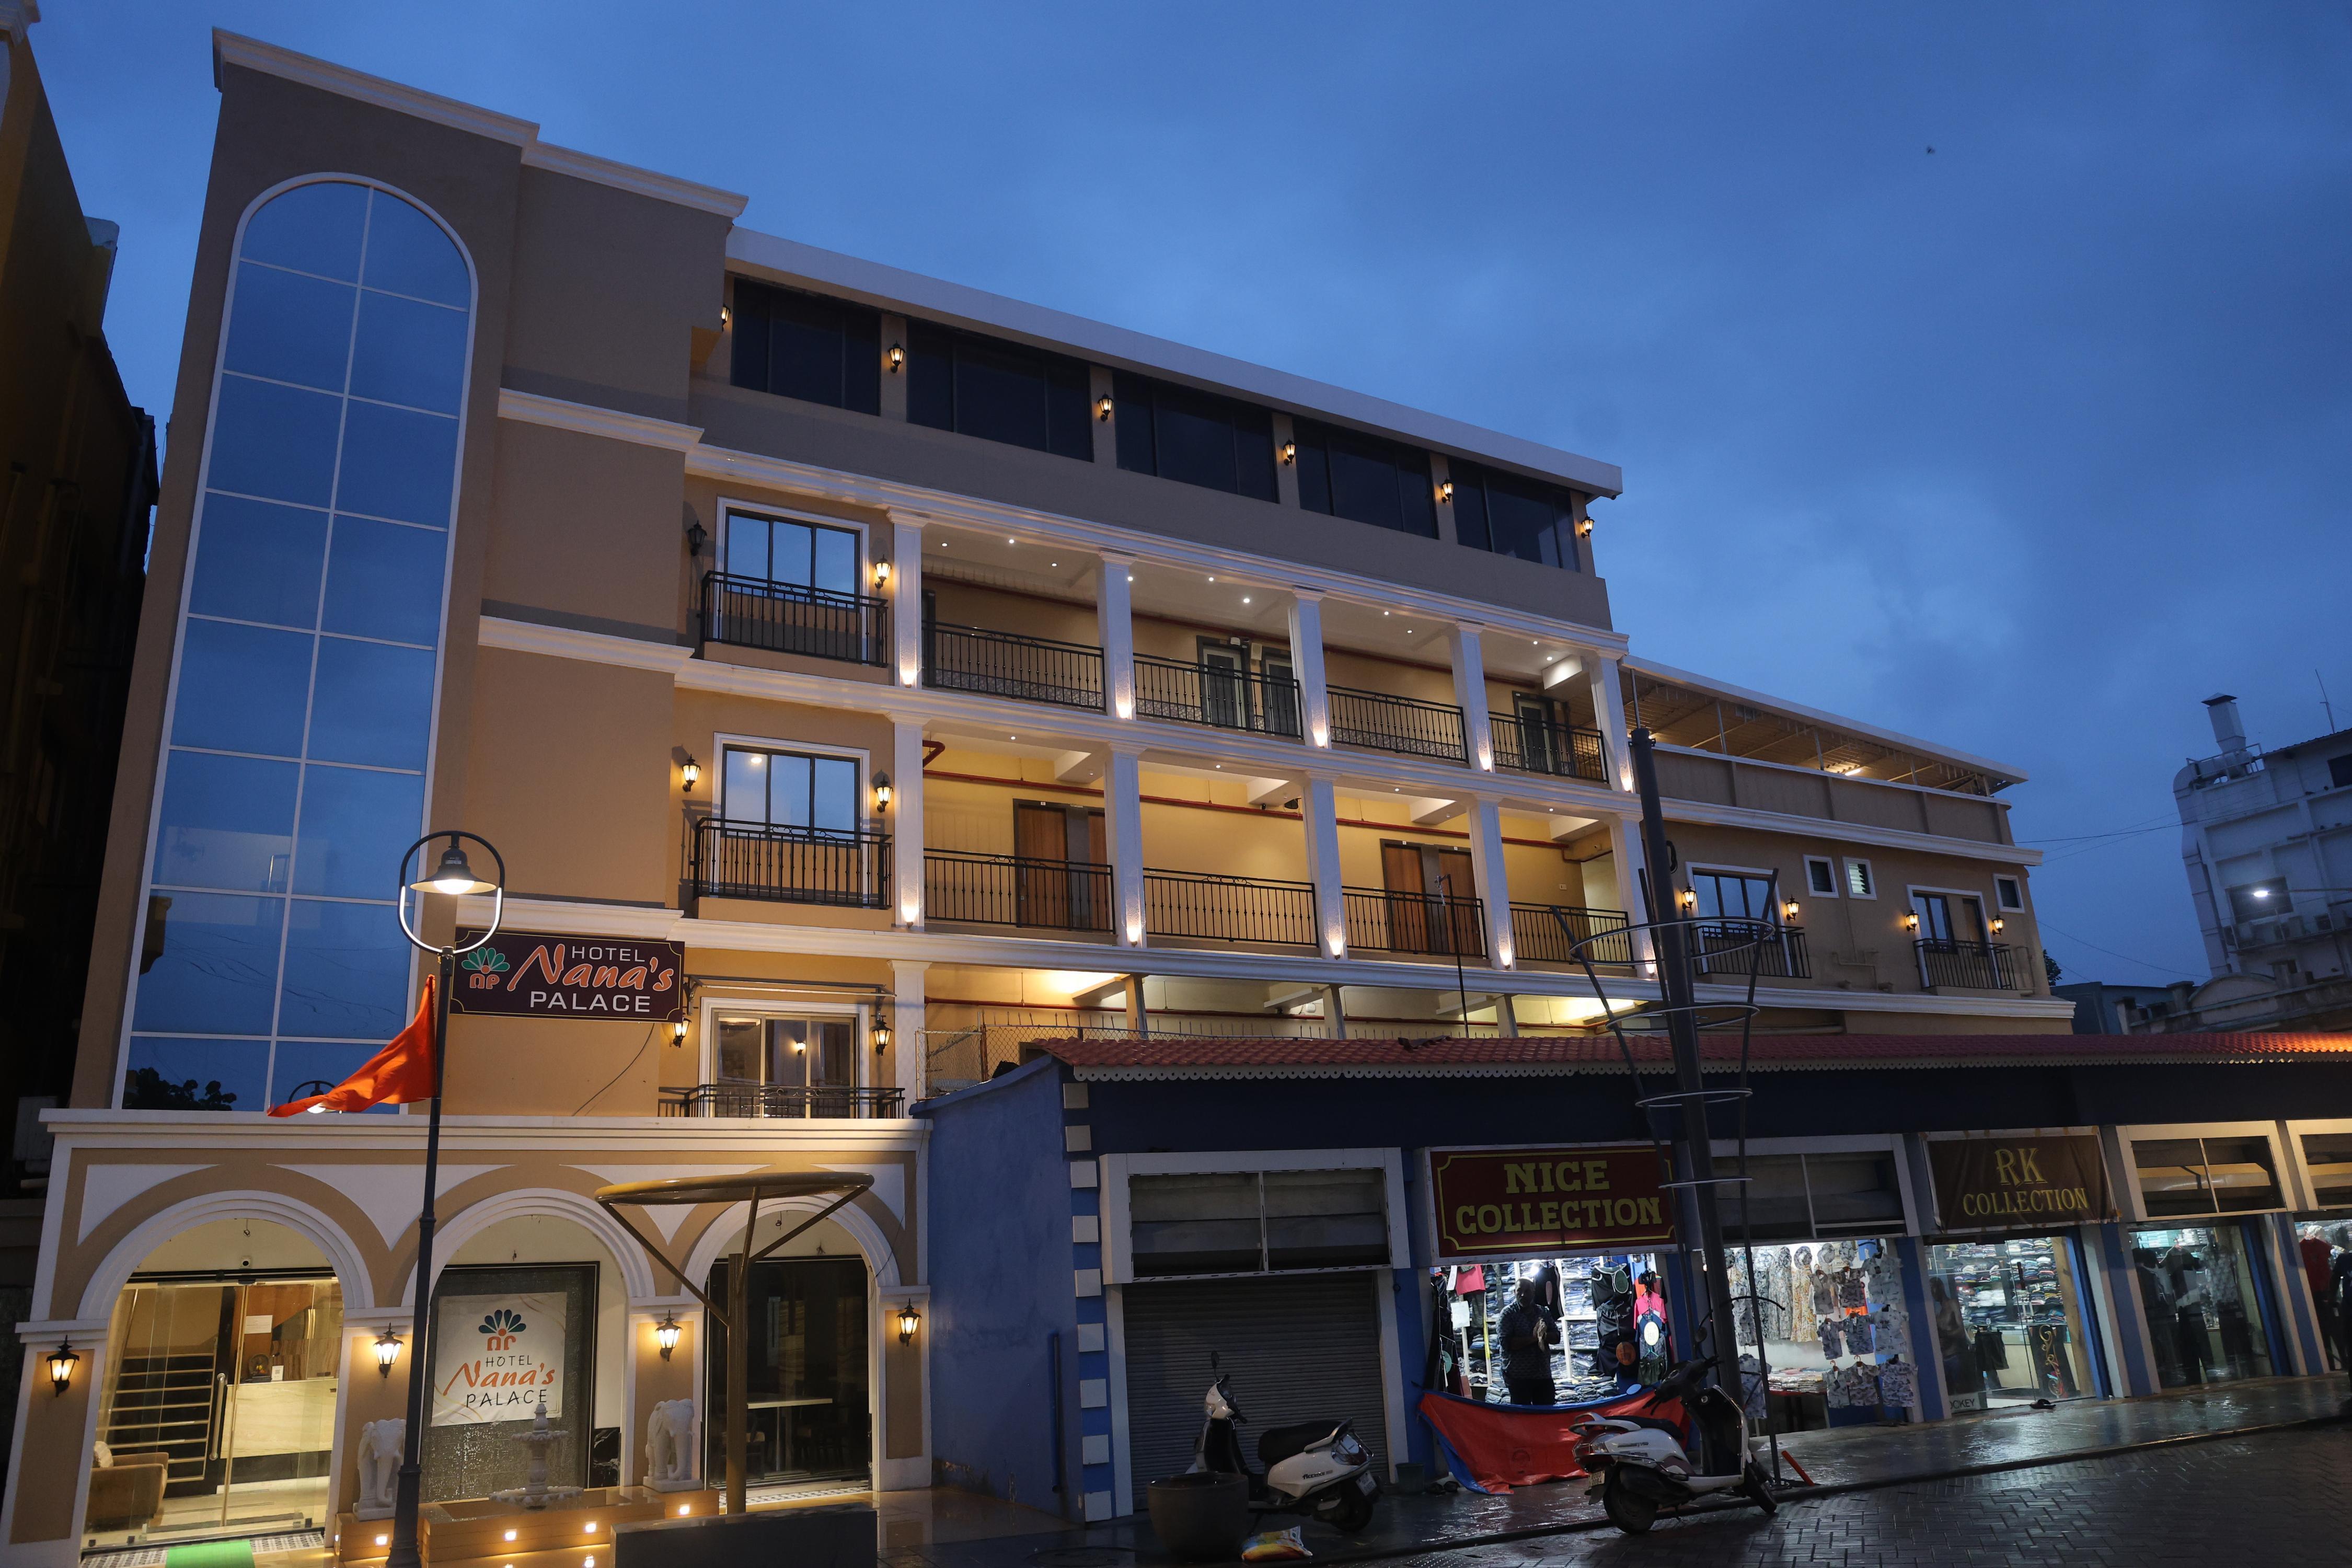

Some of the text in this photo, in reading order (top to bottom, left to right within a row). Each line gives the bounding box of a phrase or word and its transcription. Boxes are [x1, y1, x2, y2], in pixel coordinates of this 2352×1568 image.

[506, 943, 674, 991] Nana's
[571, 946, 645, 962] HOTEL
[530, 991, 651, 1012] PALACE
[1504, 1160, 1610, 1194] NICE
[1994, 1147, 2048, 1187] RK
[1456, 1197, 1663, 1235] COLLECTION
[1963, 1187, 2090, 1217] COLLECTION
[486, 1355, 532, 1367] HOTEL
[443, 1360, 555, 1397] Nana's
[466, 1389, 547, 1408] PALACE
